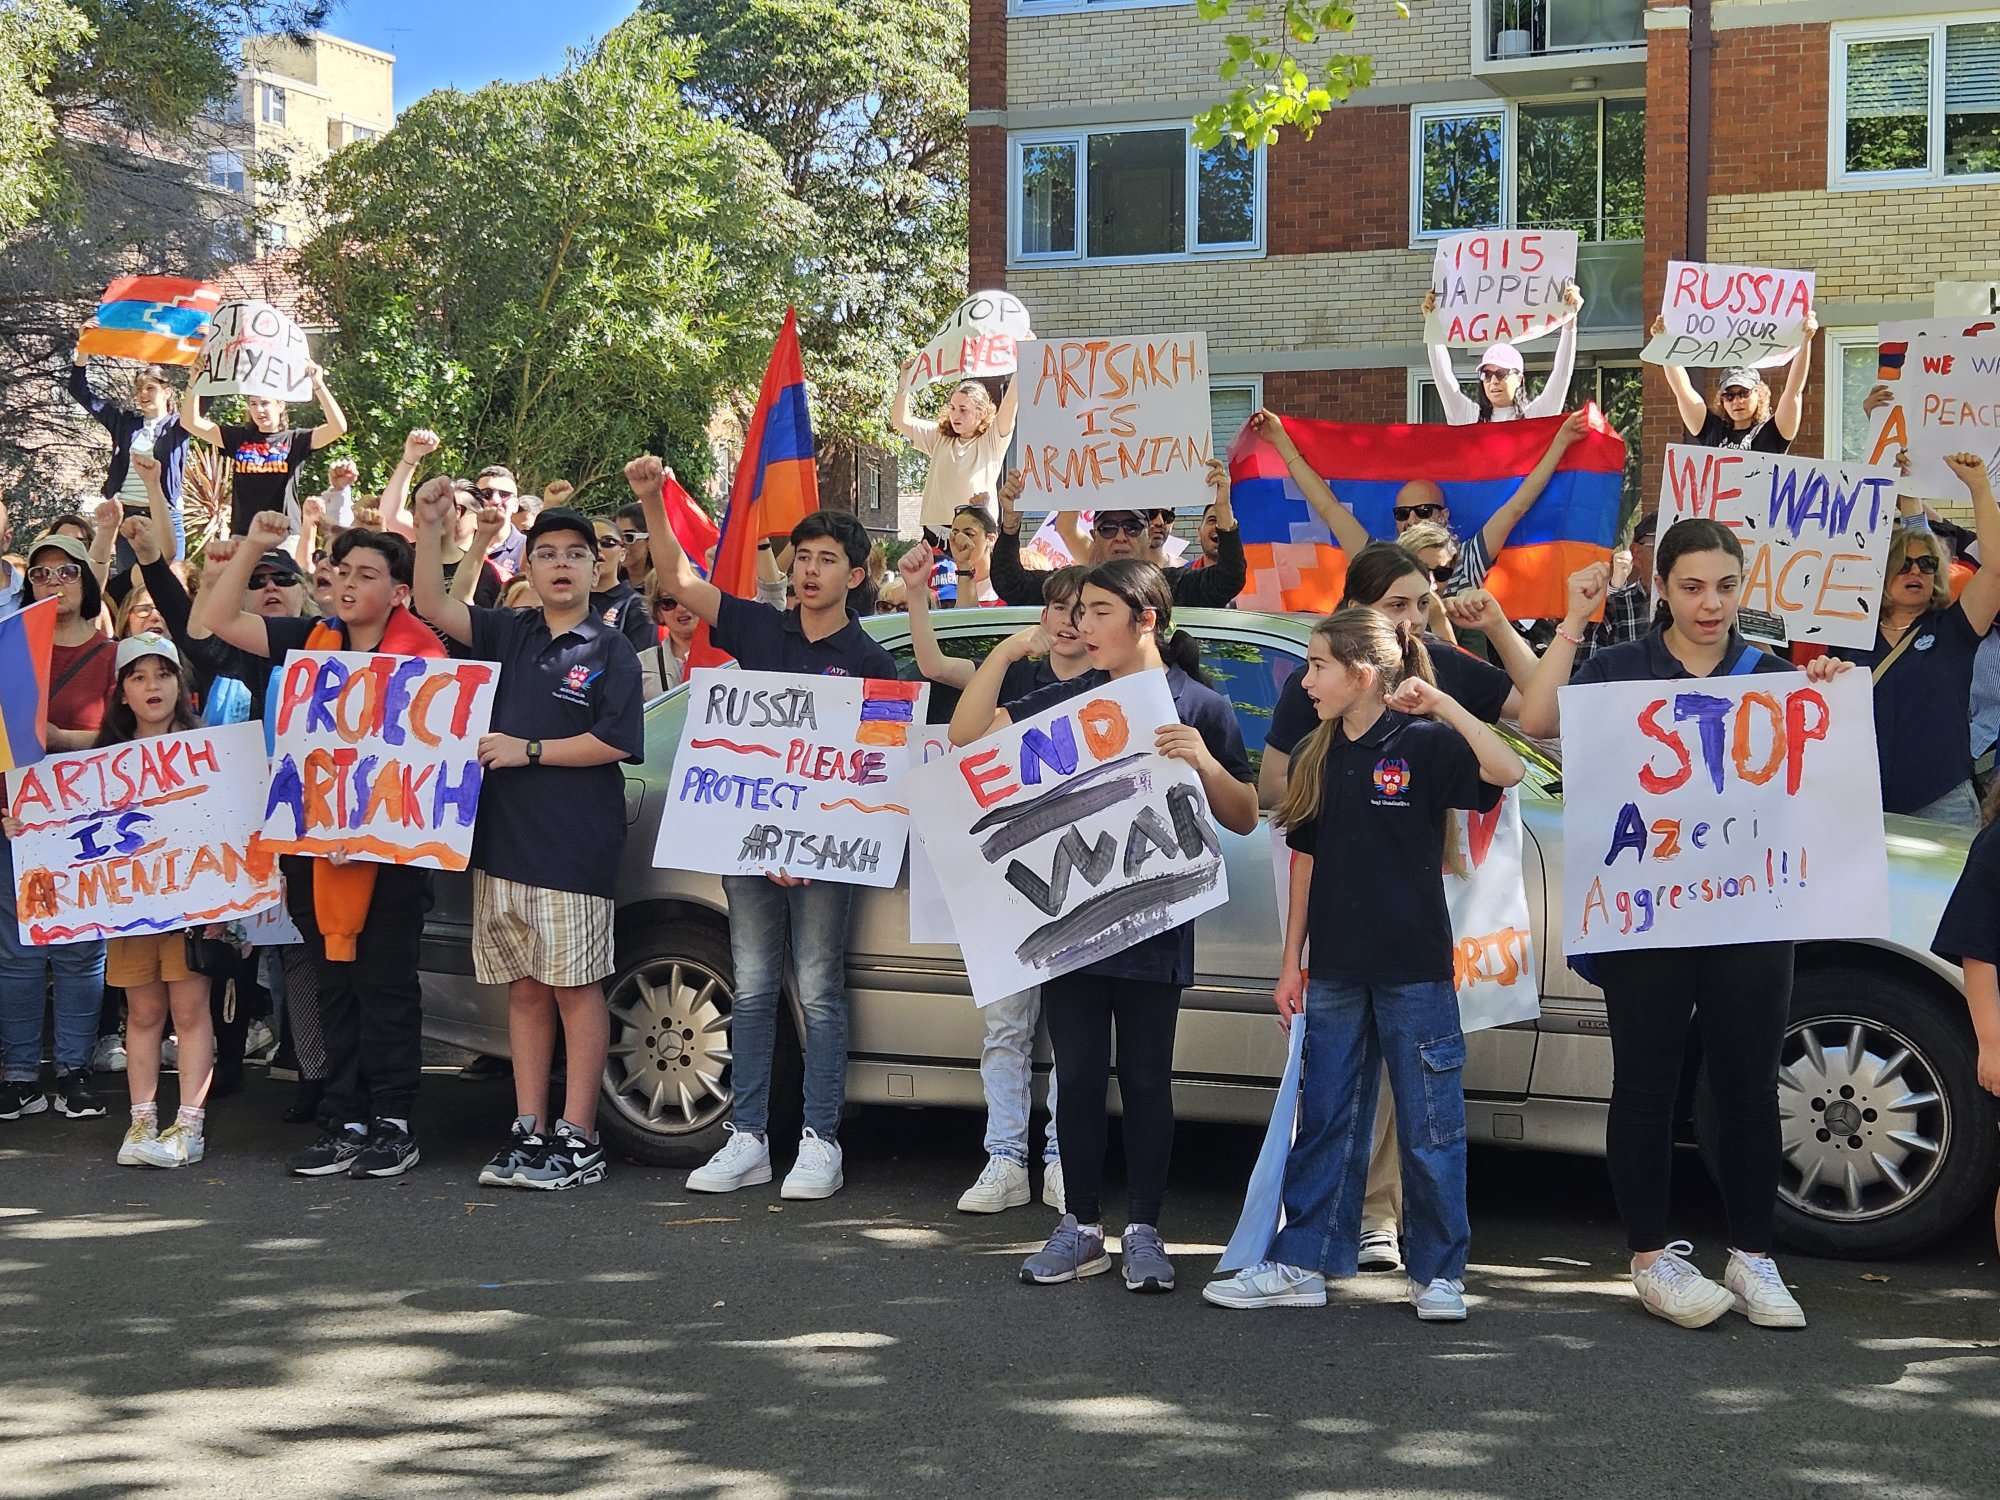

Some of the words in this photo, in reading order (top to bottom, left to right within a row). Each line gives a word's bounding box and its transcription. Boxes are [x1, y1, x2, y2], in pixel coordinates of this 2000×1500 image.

[1455, 236, 1544, 272] 1915
[1673, 267, 1809, 317] RUSSIA
[1665, 335, 1788, 363] PART
[1686, 313, 1715, 335] DO
[1726, 316, 1778, 341] YOUR
[1033, 339, 1196, 408] ARTSAKH
[1923, 354, 1955, 375] WE
[1077, 403, 1137, 437] IS
[1017, 431, 1211, 493] ARMENIAN
[1668, 448, 1743, 527] WE
[1768, 463, 1894, 538] WANT
[277, 656, 493, 747] PROTECT
[705, 684, 818, 730] RUSSIA
[785, 738, 888, 786] PLEASE
[960, 698, 1130, 808] END
[1637, 687, 1830, 796] STOP
[12, 739, 221, 822] ARTSAKH
[265, 747, 482, 841] ARTSAKH
[680, 766, 807, 811] PROTECT
[66, 811, 154, 861] IS
[1004, 782, 1221, 917] WAR
[1604, 802, 1758, 866] Azeri
[18, 836, 277, 924] ARMENIAN
